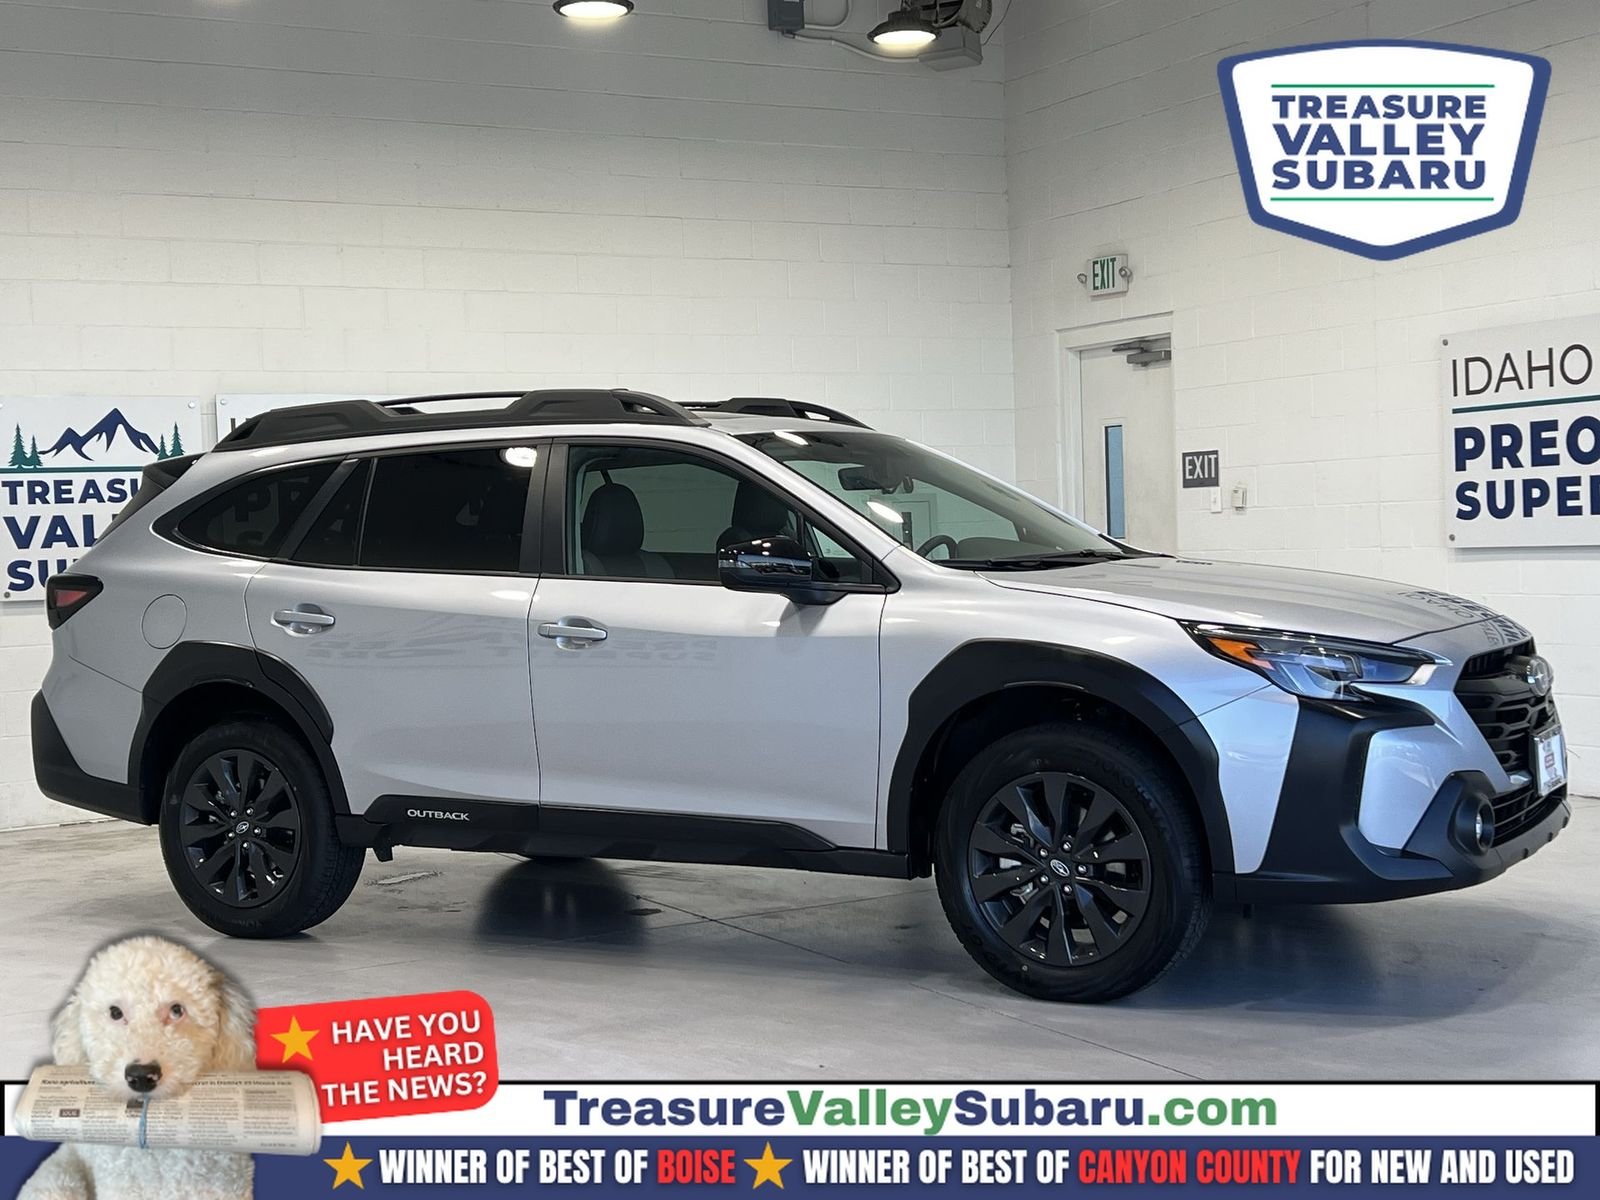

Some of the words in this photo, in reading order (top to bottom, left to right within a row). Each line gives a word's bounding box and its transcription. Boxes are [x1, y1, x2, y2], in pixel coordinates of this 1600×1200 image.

[1092, 257, 1117, 291] EXIT
[1452, 343, 1593, 397] IDAHO
[1454, 415, 1600, 472] PREO
[1184, 454, 1218, 480] EXIT
[2, 514, 119, 550] VAL
[407, 809, 471, 822] OUTBACK
